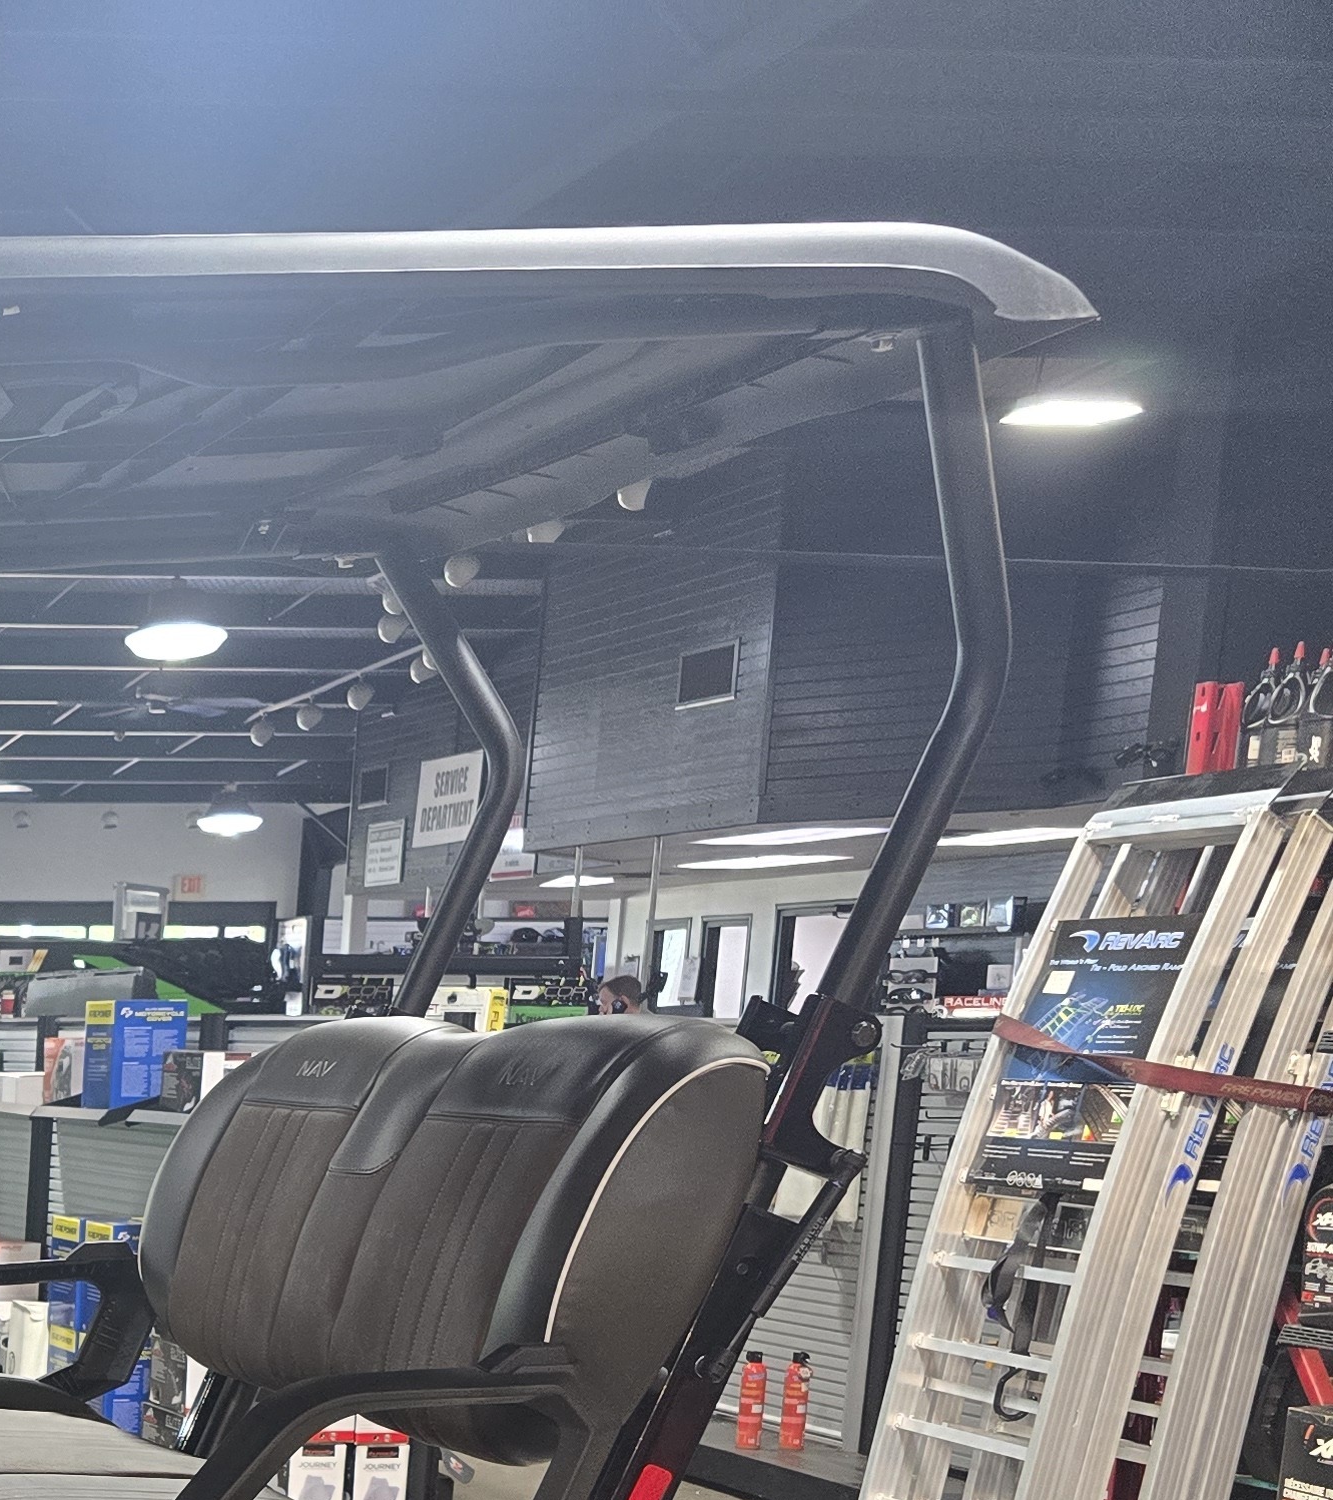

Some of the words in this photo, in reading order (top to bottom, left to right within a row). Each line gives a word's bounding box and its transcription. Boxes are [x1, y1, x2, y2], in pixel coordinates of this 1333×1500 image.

[434, 766, 470, 798] SERVICE
[419, 799, 475, 833] DEPARTMENT
[296, 1060, 338, 1078] NAV
[298, 1461, 338, 1469] JOURNEY
[363, 1463, 402, 1471] JOURNEY
